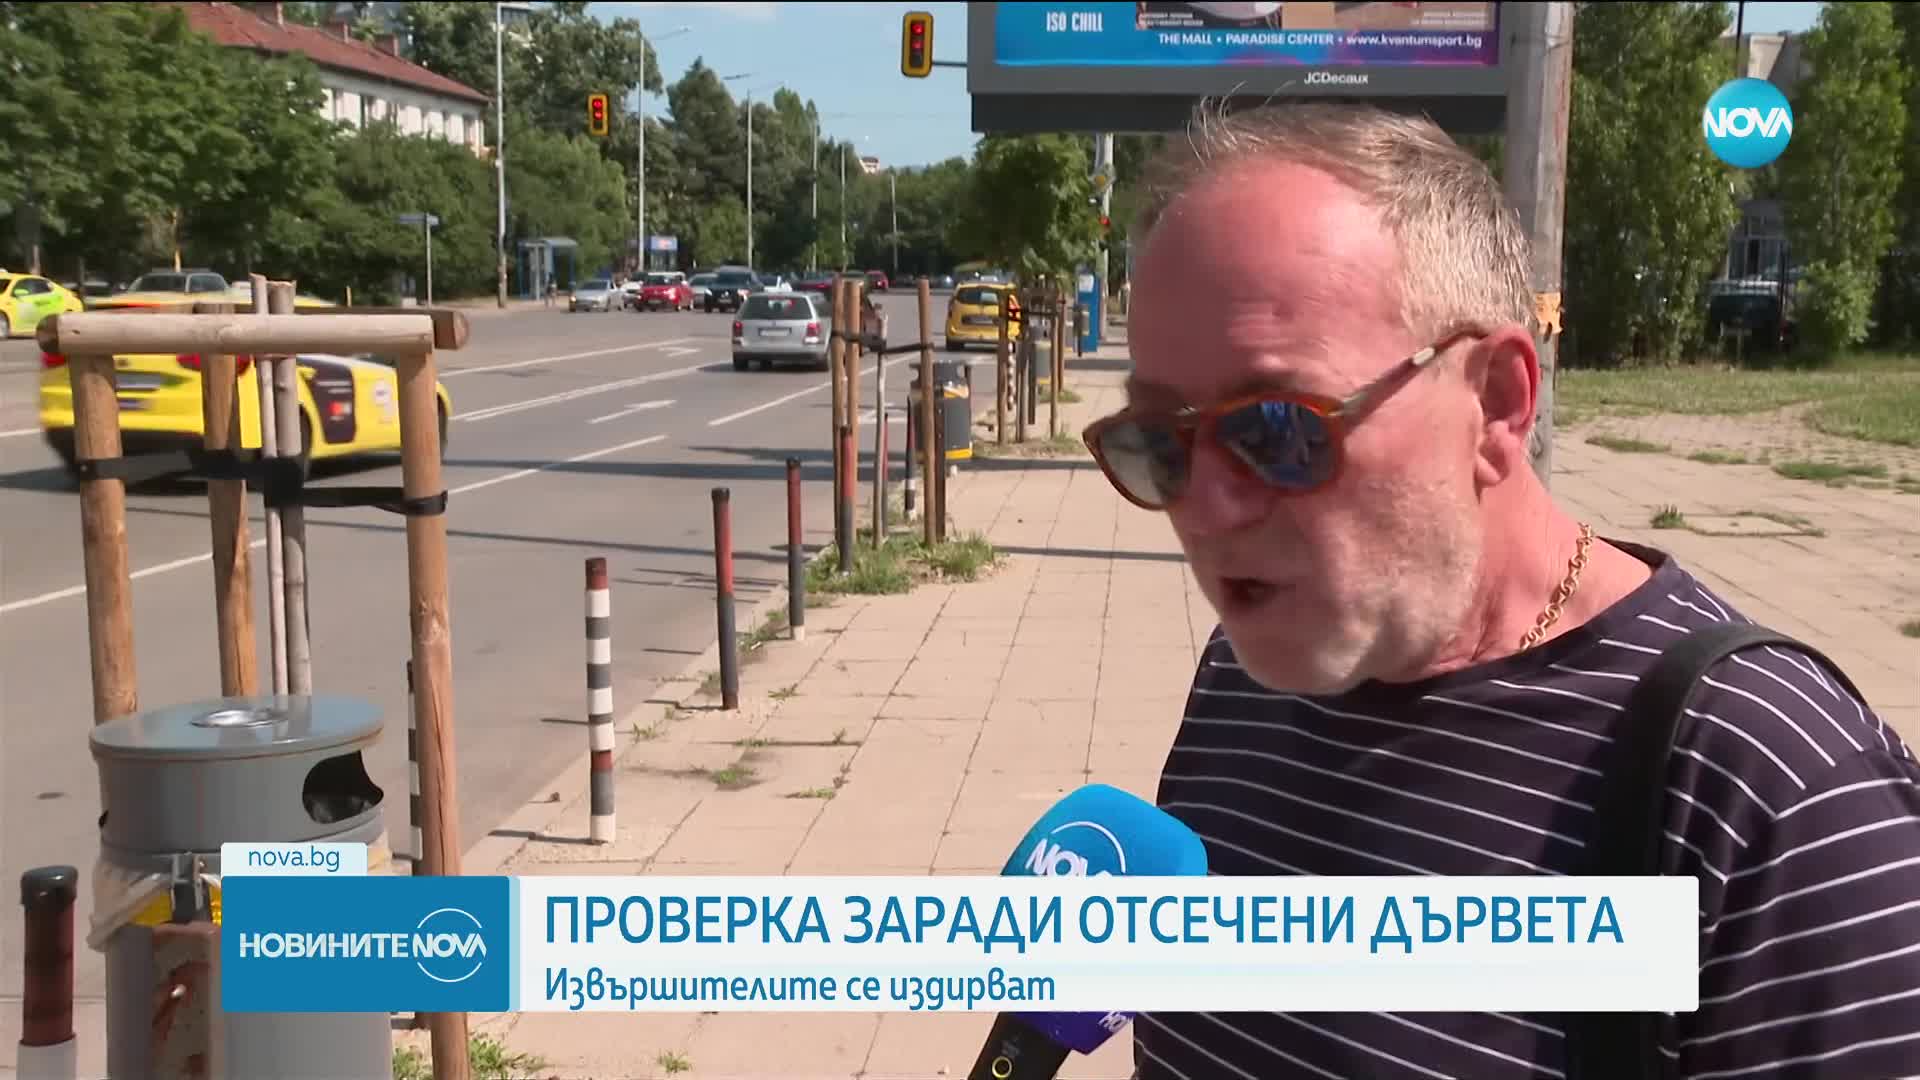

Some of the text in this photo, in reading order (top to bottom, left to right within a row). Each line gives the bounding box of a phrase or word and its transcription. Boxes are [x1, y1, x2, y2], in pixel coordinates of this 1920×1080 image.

[1046, 12, 1103, 32] ISO CHILL
[1159, 33, 1482, 48] THE MALL PARADISE CENTER www.kvantumsport.bg
[1303, 72, 1369, 85] JCDecaux
